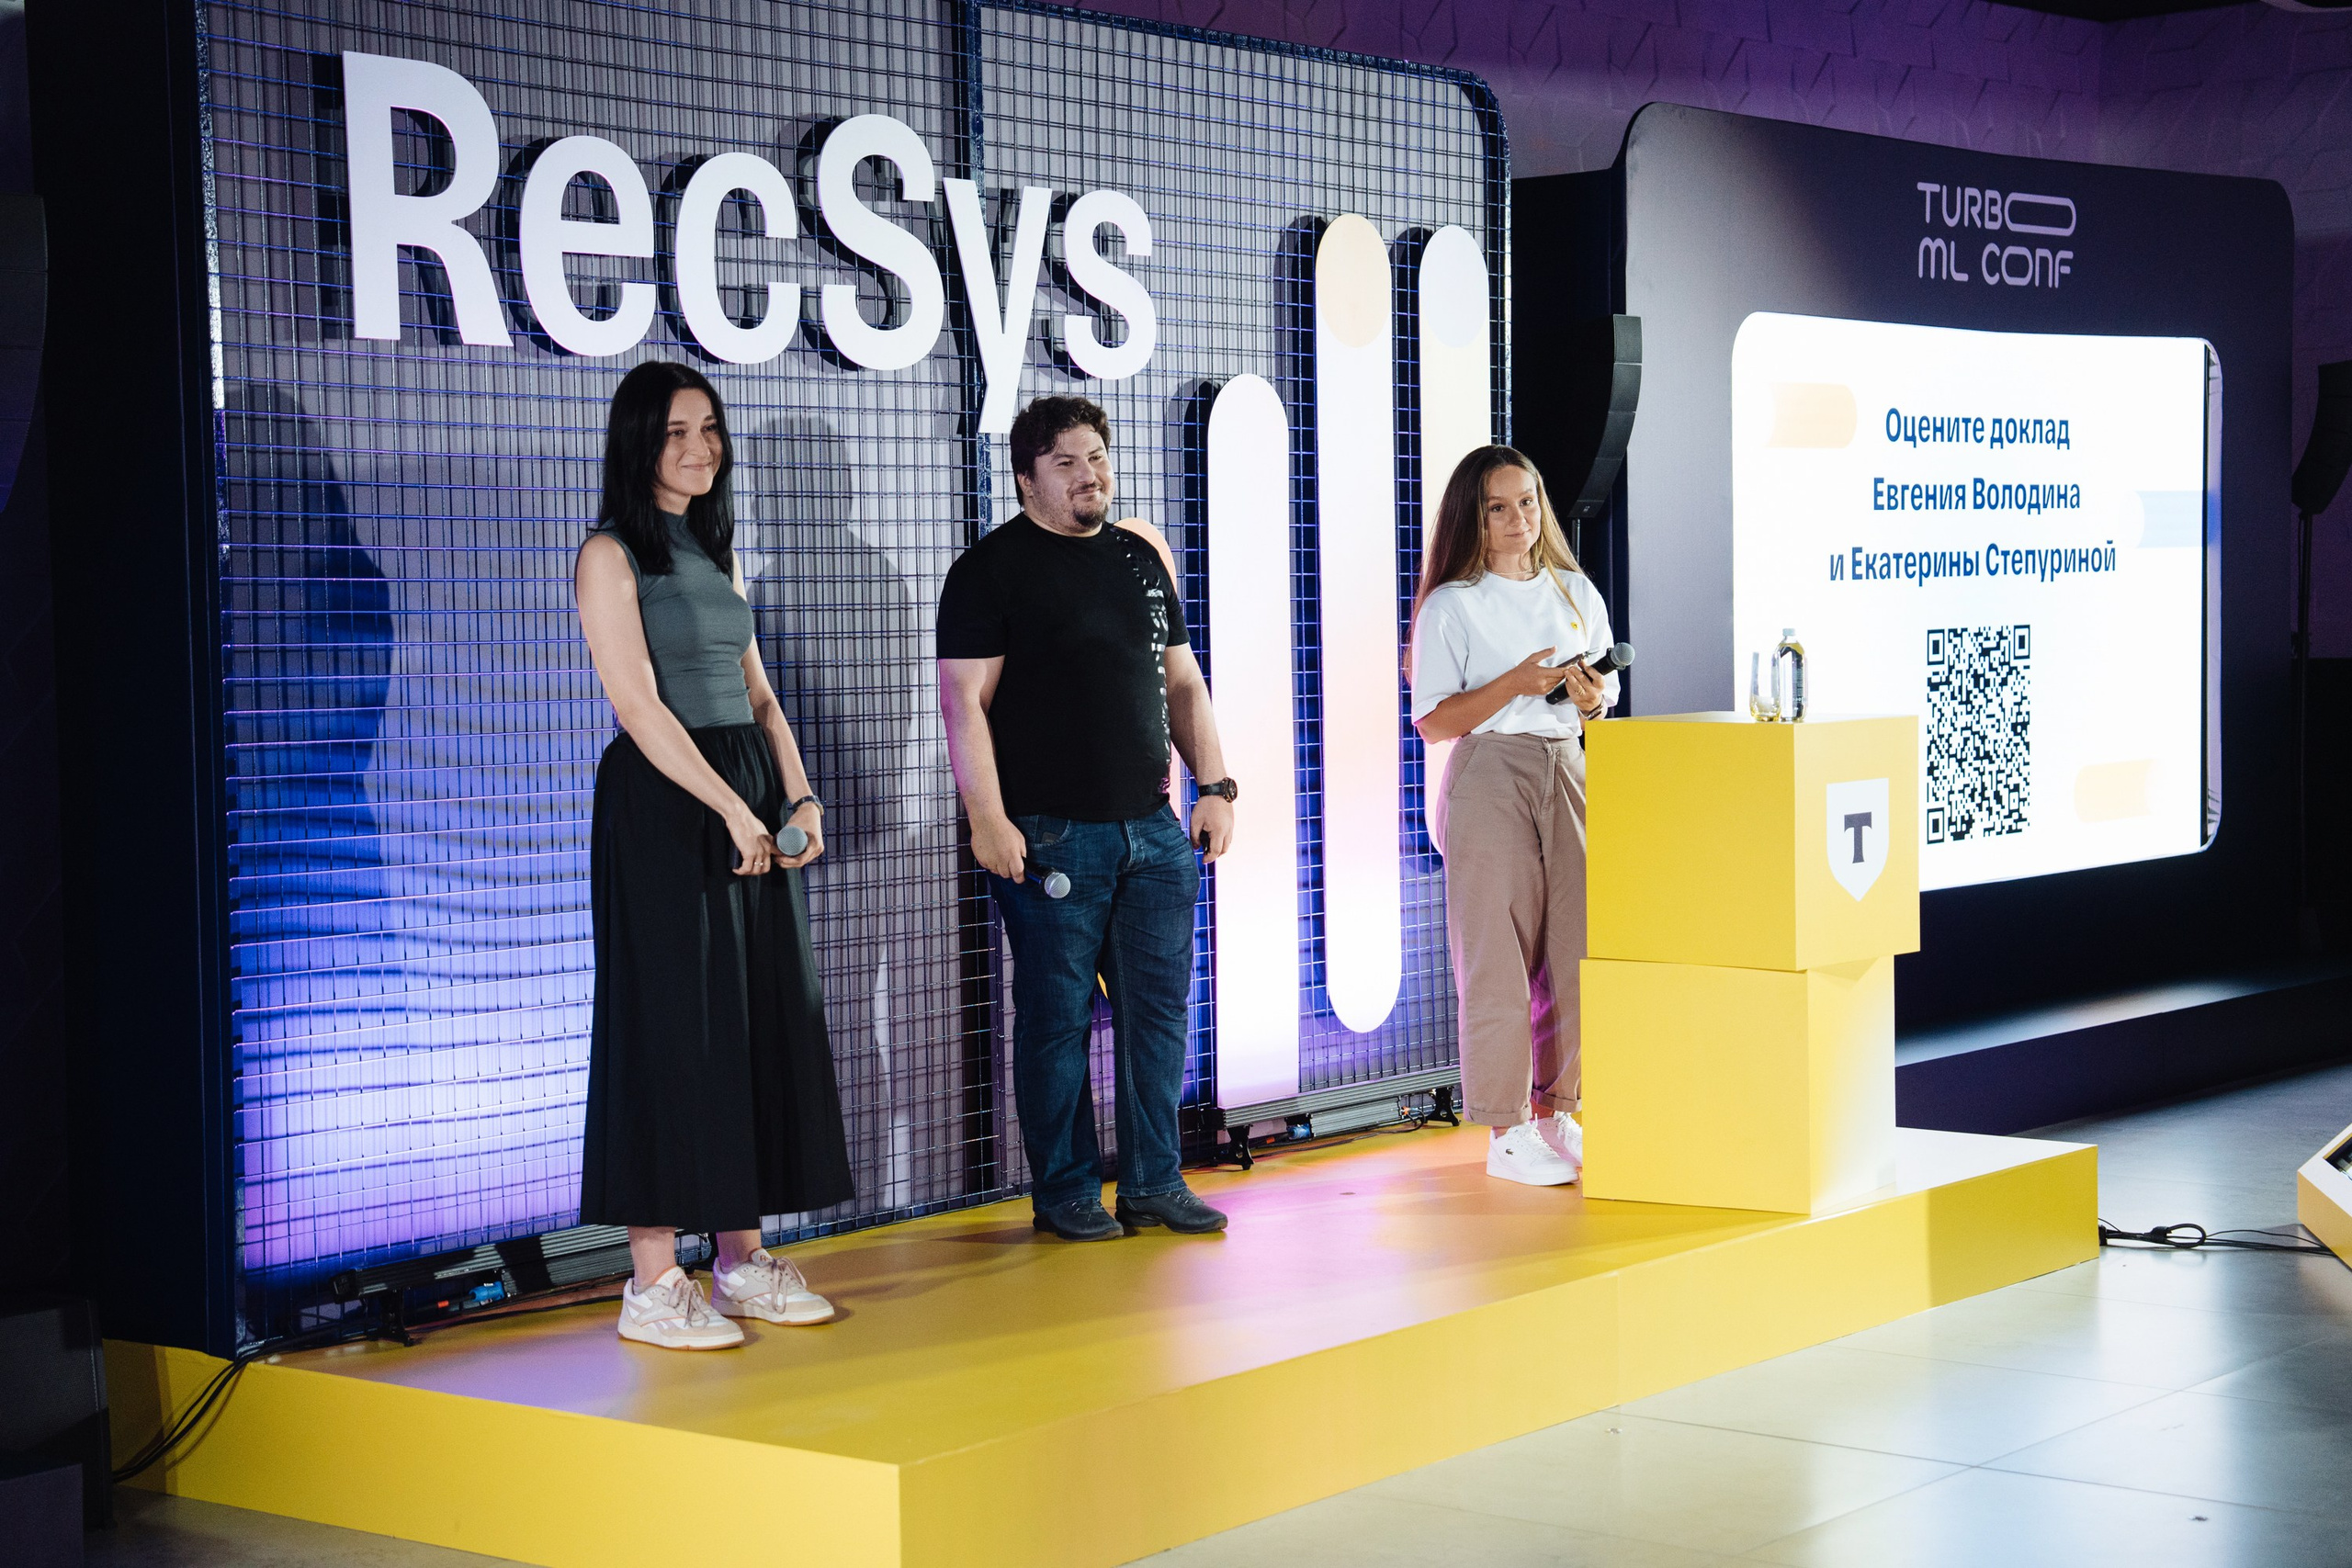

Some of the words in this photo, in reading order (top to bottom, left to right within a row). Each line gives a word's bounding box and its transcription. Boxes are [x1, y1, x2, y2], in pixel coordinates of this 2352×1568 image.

[1917, 182, 2077, 237] TURBO
[343, 51, 1158, 434] RecSys
[1917, 237, 1969, 282] ML
[1981, 243, 2075, 288] CONF
[1885, 407, 1985, 449] Оцените
[1989, 417, 2071, 451] доклад
[1872, 477, 1967, 512] Евгения
[1973, 477, 2081, 515] Володина
[1829, 554, 1845, 581] и
[1851, 546, 1980, 588] Екатерины
[1984, 539, 2116, 583] Степуриной
